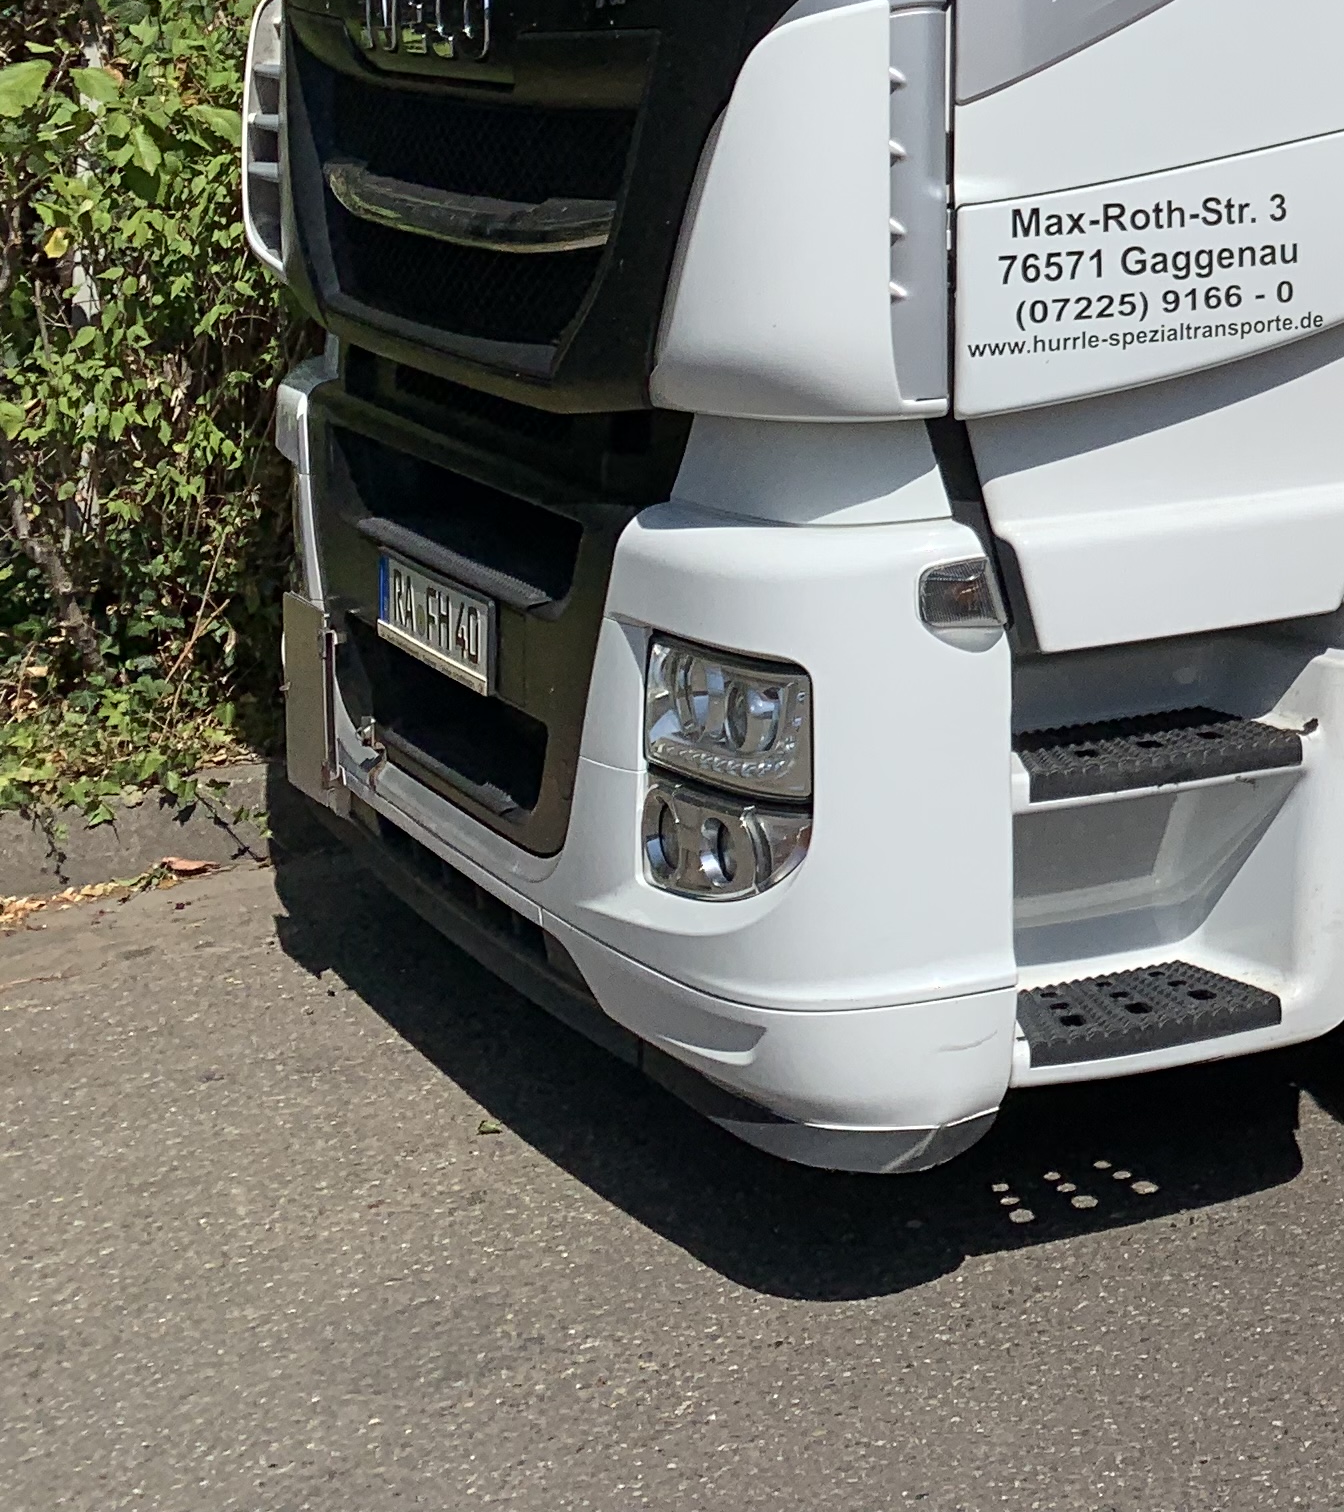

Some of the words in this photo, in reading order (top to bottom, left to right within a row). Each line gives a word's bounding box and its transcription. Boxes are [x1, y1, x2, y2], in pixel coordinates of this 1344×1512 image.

[1010, 196, 1257, 239] Max-Roth-Str.
[1269, 194, 1288, 222] 3
[998, 248, 1103, 286] 76571
[1120, 239, 1299, 281] Gaggenau
[1016, 291, 1149, 331] (07225)
[1162, 284, 1243, 314] 9166
[1276, 280, 1294, 303] 0
[968, 311, 1324, 358] www.hurrle-spezialtransporte.de
[393, 568, 417, 634] RA
[426, 586, 452, 652] FH
